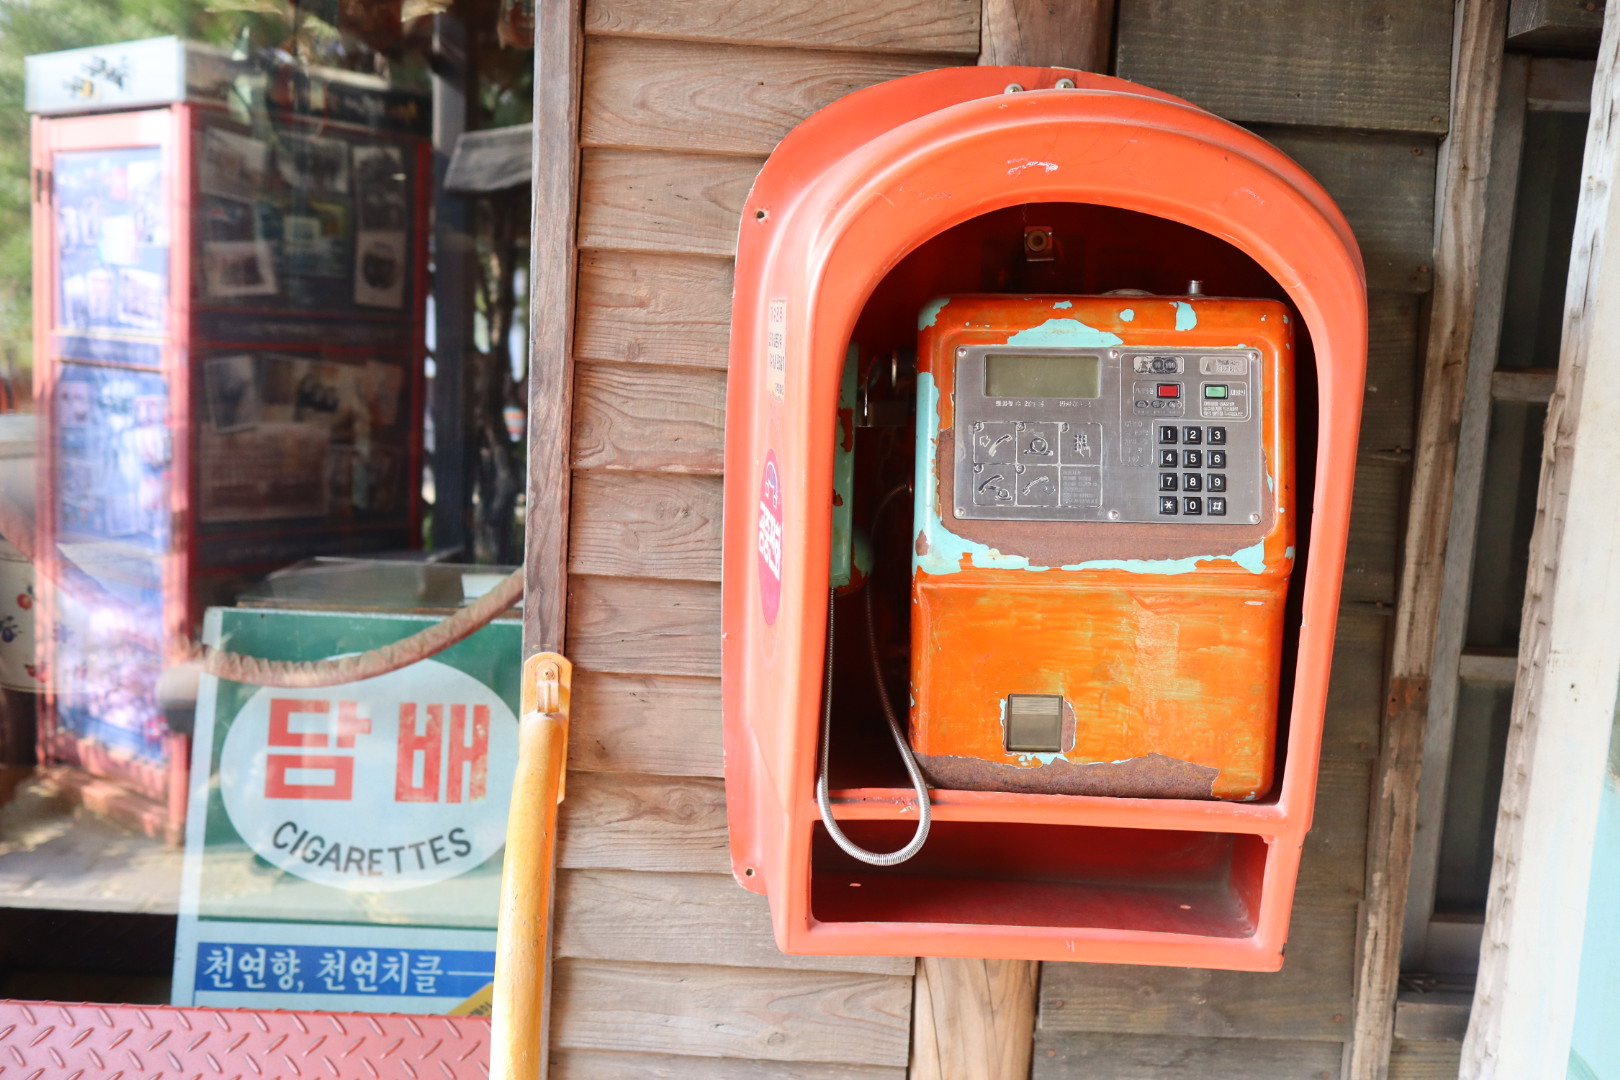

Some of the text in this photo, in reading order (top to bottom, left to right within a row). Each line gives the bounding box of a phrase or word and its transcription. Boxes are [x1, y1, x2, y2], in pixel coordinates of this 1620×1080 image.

[264, 698, 490, 804] 담배
[272, 820, 472, 876] CIGARETTES
[203, 946, 443, 994] 천연향, 천연치클
